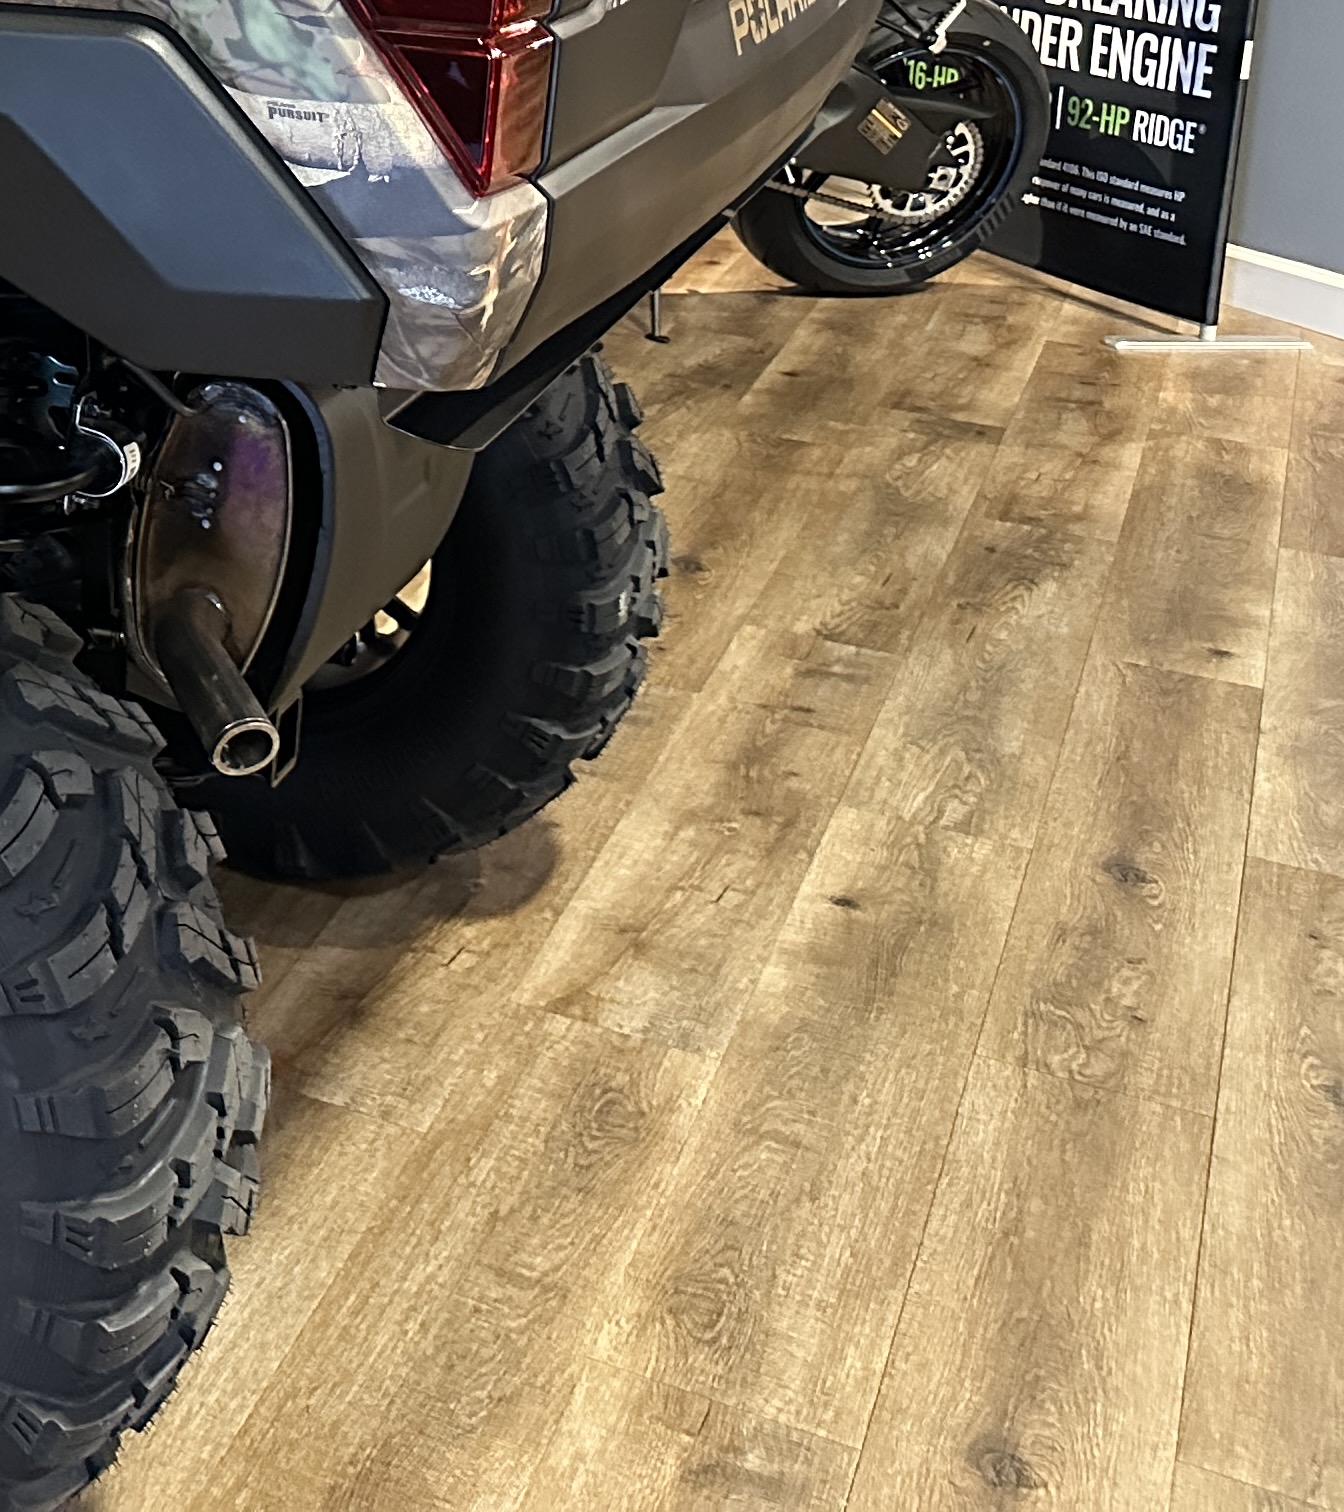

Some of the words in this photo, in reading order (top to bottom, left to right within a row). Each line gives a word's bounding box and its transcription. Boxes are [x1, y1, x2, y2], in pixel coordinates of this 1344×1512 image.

[1089, 22, 1219, 99] ENGINE
[268, 106, 324, 122] PURSUIT
[1067, 95, 1130, 137] 92-HP
[1174, 190, 1186, 202] HP
[1146, 205, 1160, 218] and
